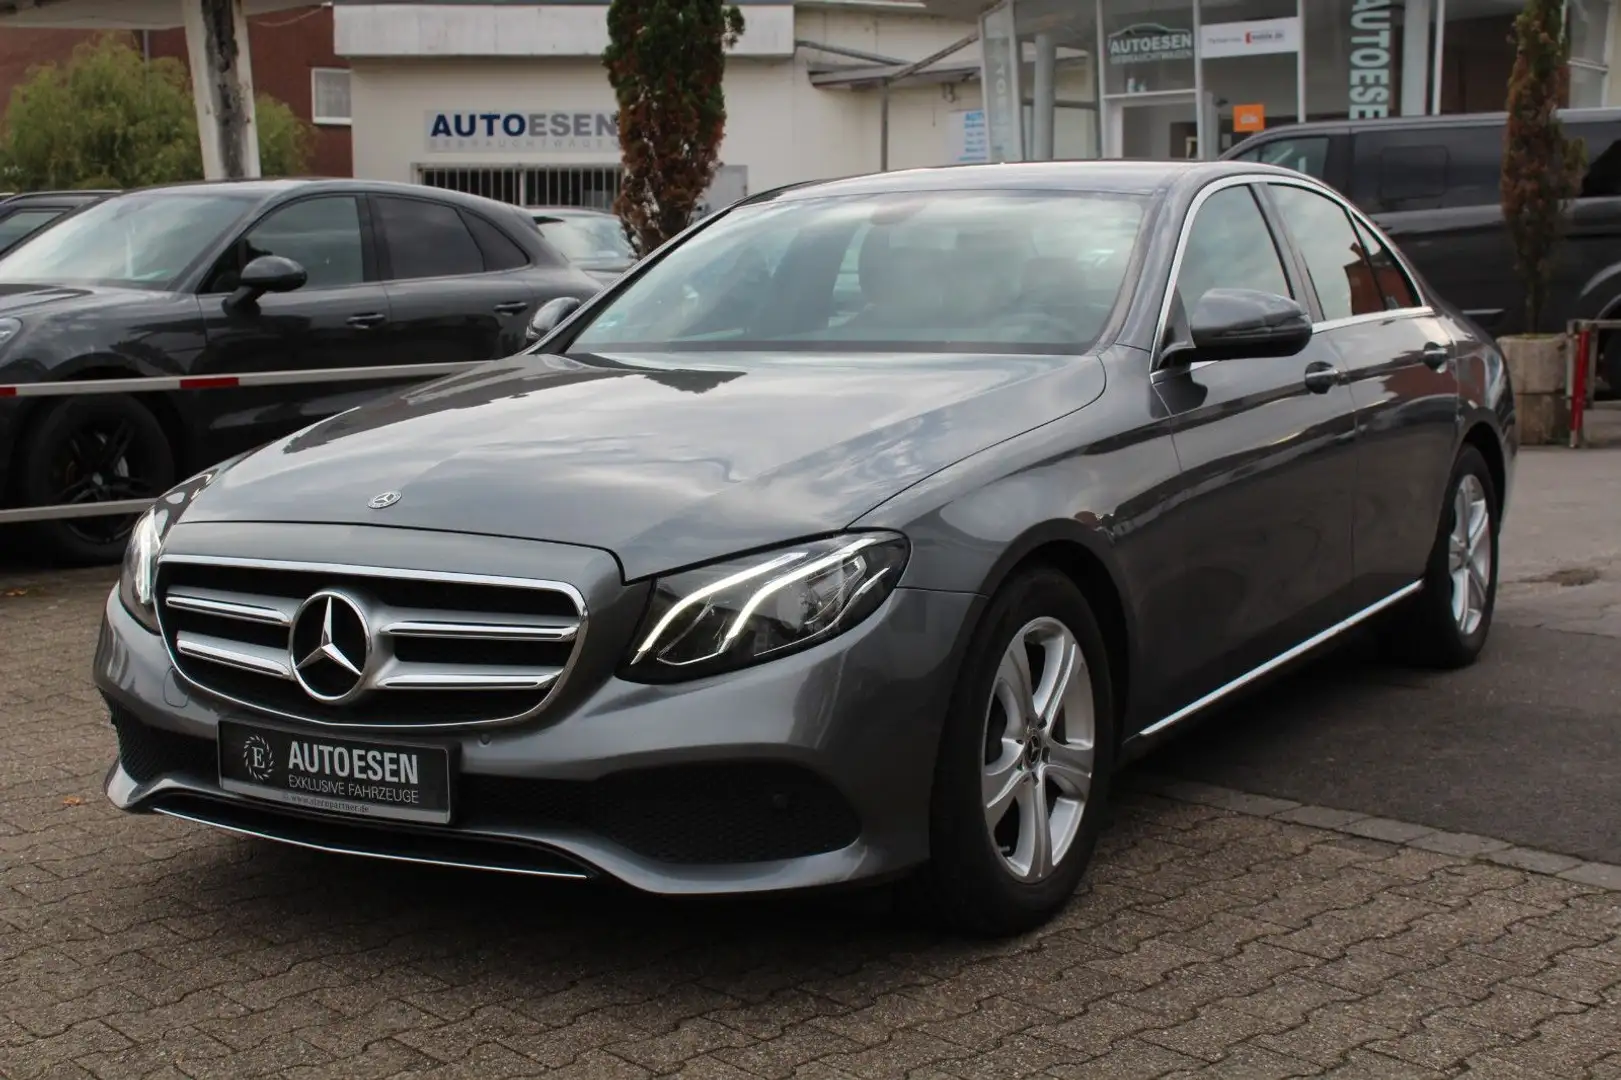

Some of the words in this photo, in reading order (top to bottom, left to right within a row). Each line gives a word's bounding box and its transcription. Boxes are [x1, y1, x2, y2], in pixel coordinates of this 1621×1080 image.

[1109, 33, 1192, 54] AUTOESEN
[430, 113, 620, 137] AUTOESEN
[252, 747, 266, 769] E
[288, 740, 419, 785] AUTOESEN
[288, 774, 346, 796] EXKLUSIVE
[348, 783, 419, 804] FAHRZEUGE
